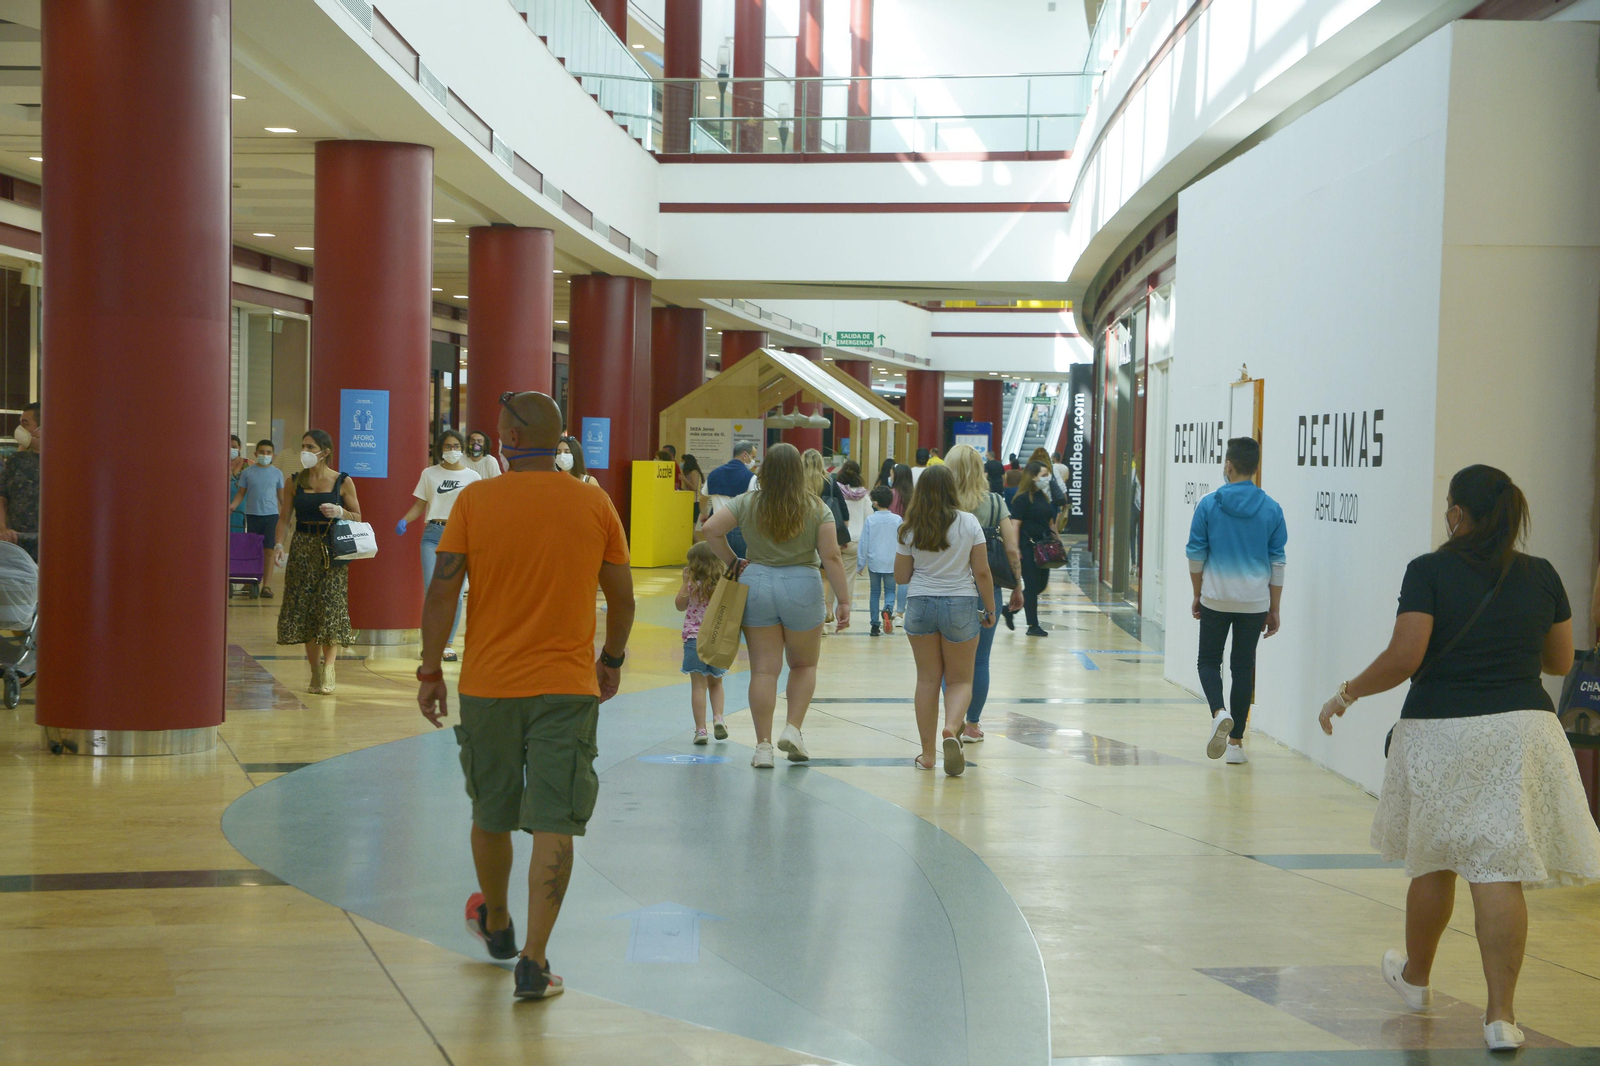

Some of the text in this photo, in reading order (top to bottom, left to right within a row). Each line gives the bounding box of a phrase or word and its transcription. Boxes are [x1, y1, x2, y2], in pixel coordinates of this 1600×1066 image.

[1068, 393, 1085, 516] pullandbear.com
[1174, 421, 1223, 464] DECIMAS
[1297, 409, 1384, 467] DECIMAS
[441, 479, 460, 488] NIKE
[1314, 491, 1359, 524] ABRIL 2020
